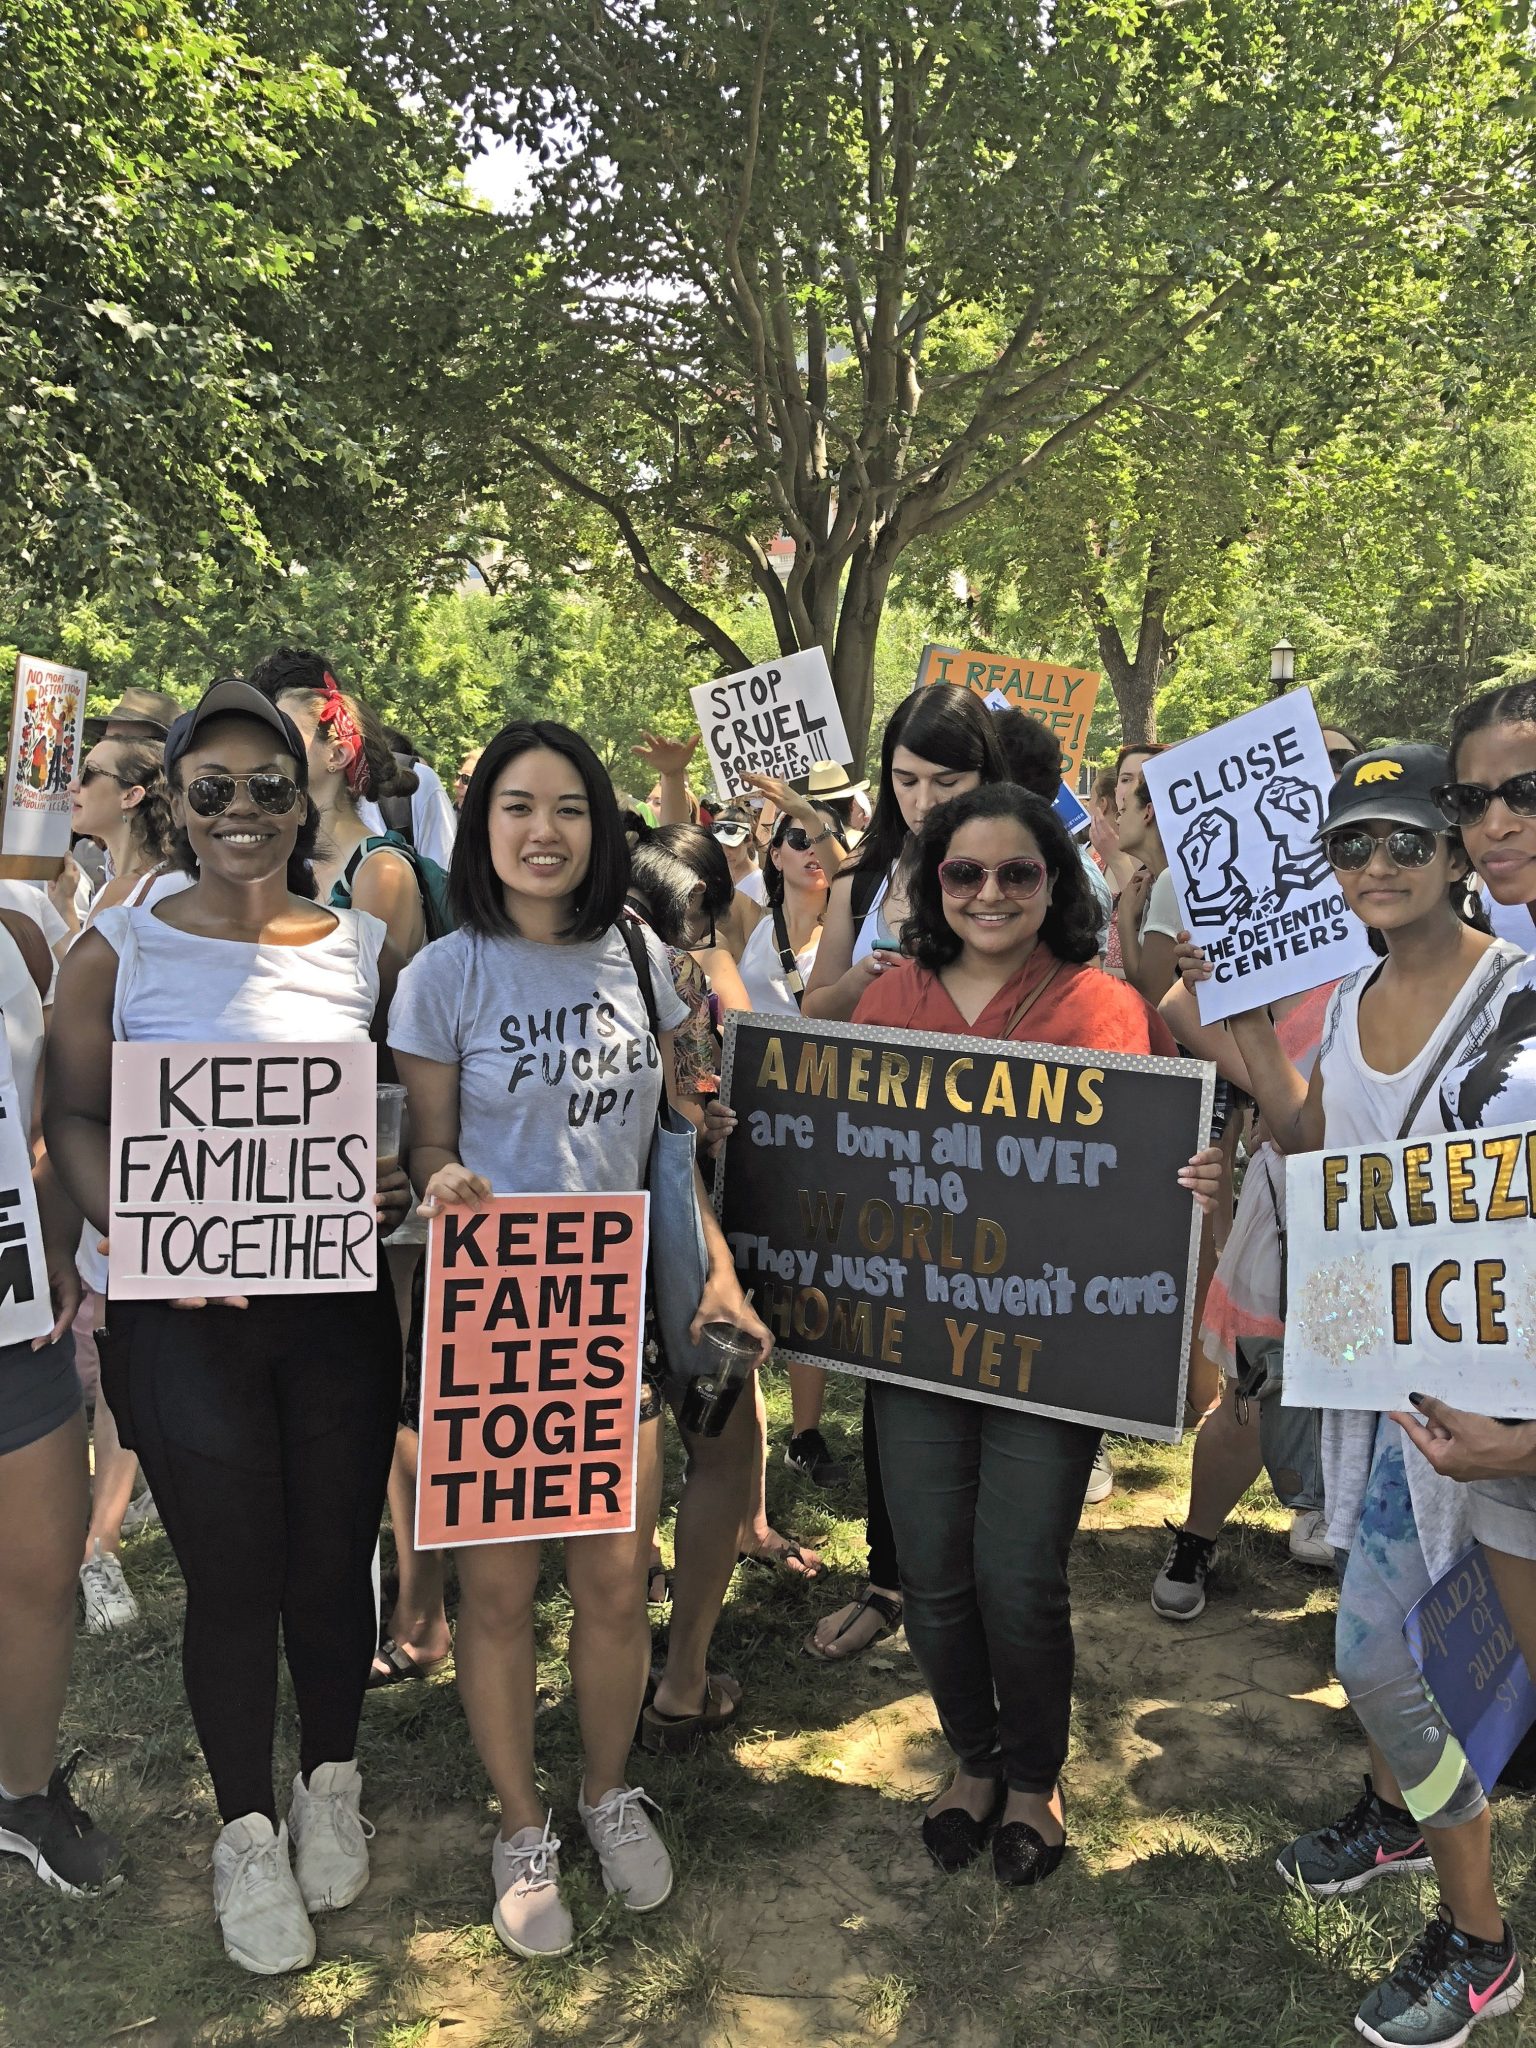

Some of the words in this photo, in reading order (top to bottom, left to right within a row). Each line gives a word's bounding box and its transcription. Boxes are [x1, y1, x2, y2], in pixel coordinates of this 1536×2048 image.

[26, 669, 43, 685] NO
[45, 672, 65, 683] MORE
[710, 669, 782, 720] STOP
[934, 657, 953, 684] I
[965, 661, 1085, 707] REALLY
[710, 699, 828, 760] CRUEL
[719, 742, 800, 780] BORDER
[726, 754, 811, 798] POICIES
[1168, 726, 1305, 815] CLOSE
[1215, 917, 1349, 984] CENTERS
[500, 991, 616, 1053] SHIT'S
[160, 1057, 342, 1131] KEEP
[567, 1088, 635, 1129] UP!
[756, 1037, 1105, 1127] AMERICANS
[120, 1133, 368, 1204] FAMILIES
[747, 1110, 815, 1149] are
[931, 1122, 983, 1171] all
[888, 1165, 968, 1214] the
[115, 1210, 374, 1280] TOGETHER
[442, 1211, 634, 1268] KEEP
[797, 1189, 1008, 1276] WORLD
[441, 1273, 629, 1333] FAMI
[727, 1231, 819, 1286] They
[924, 1262, 1076, 1317] haven't
[1083, 1270, 1179, 1315] come
[1391, 1258, 1510, 1346] ICE
[438, 1335, 626, 1398] LIES
[762, 1280, 907, 1364] HOME
[944, 1316, 1043, 1394] YET
[432, 1397, 623, 1462] TOGE
[430, 1461, 622, 1527] THER
[1471, 1601, 1496, 1636] to
